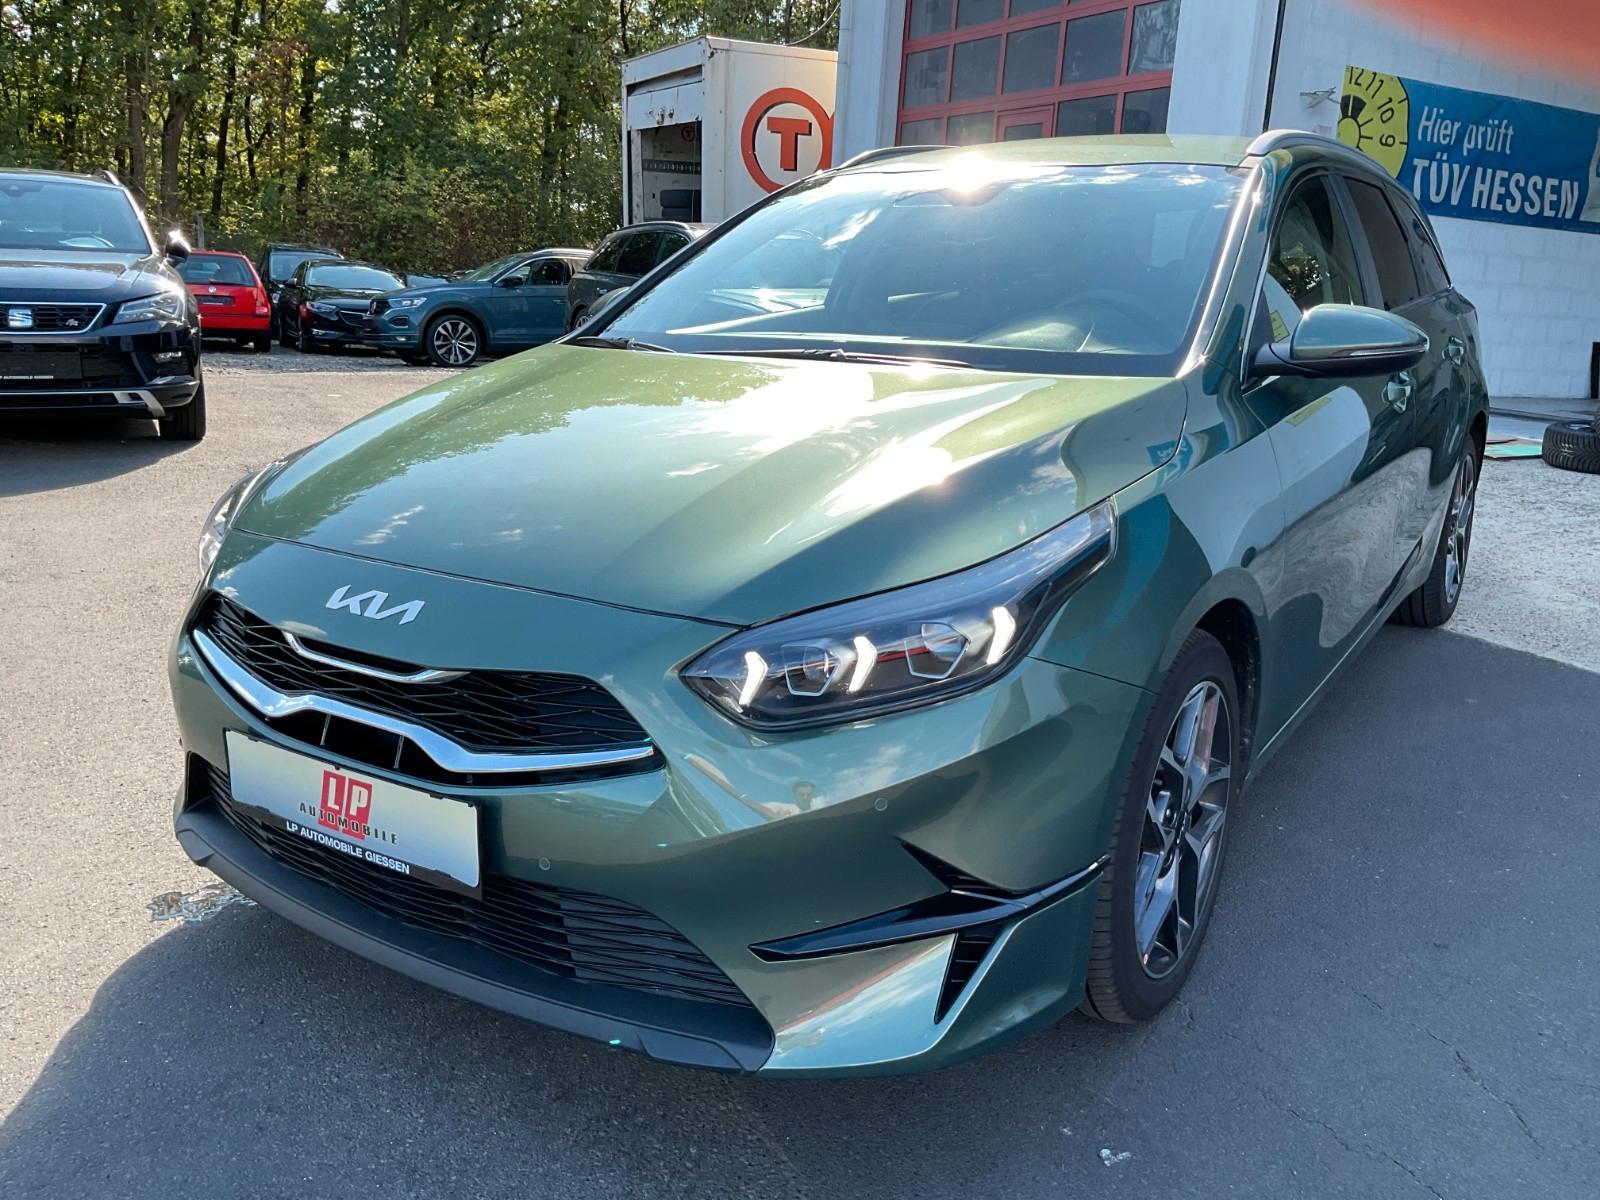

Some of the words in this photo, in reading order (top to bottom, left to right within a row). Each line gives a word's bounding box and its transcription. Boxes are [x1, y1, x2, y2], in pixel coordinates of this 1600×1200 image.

[1365, 71, 1385, 99] 11
[1377, 97, 1395, 124] 10
[767, 116, 812, 172] T
[1417, 105, 1462, 146] Hier
[1462, 119, 1515, 157] prüft
[1412, 151, 1471, 206] TÜV
[1471, 166, 1579, 220] HESSEN
[286, 820, 299, 832] LP
[300, 827, 364, 859] AUTOMOBILE
[365, 850, 411, 875] GIESSEN
[299, 801, 399, 846] AUTOMOBILE
